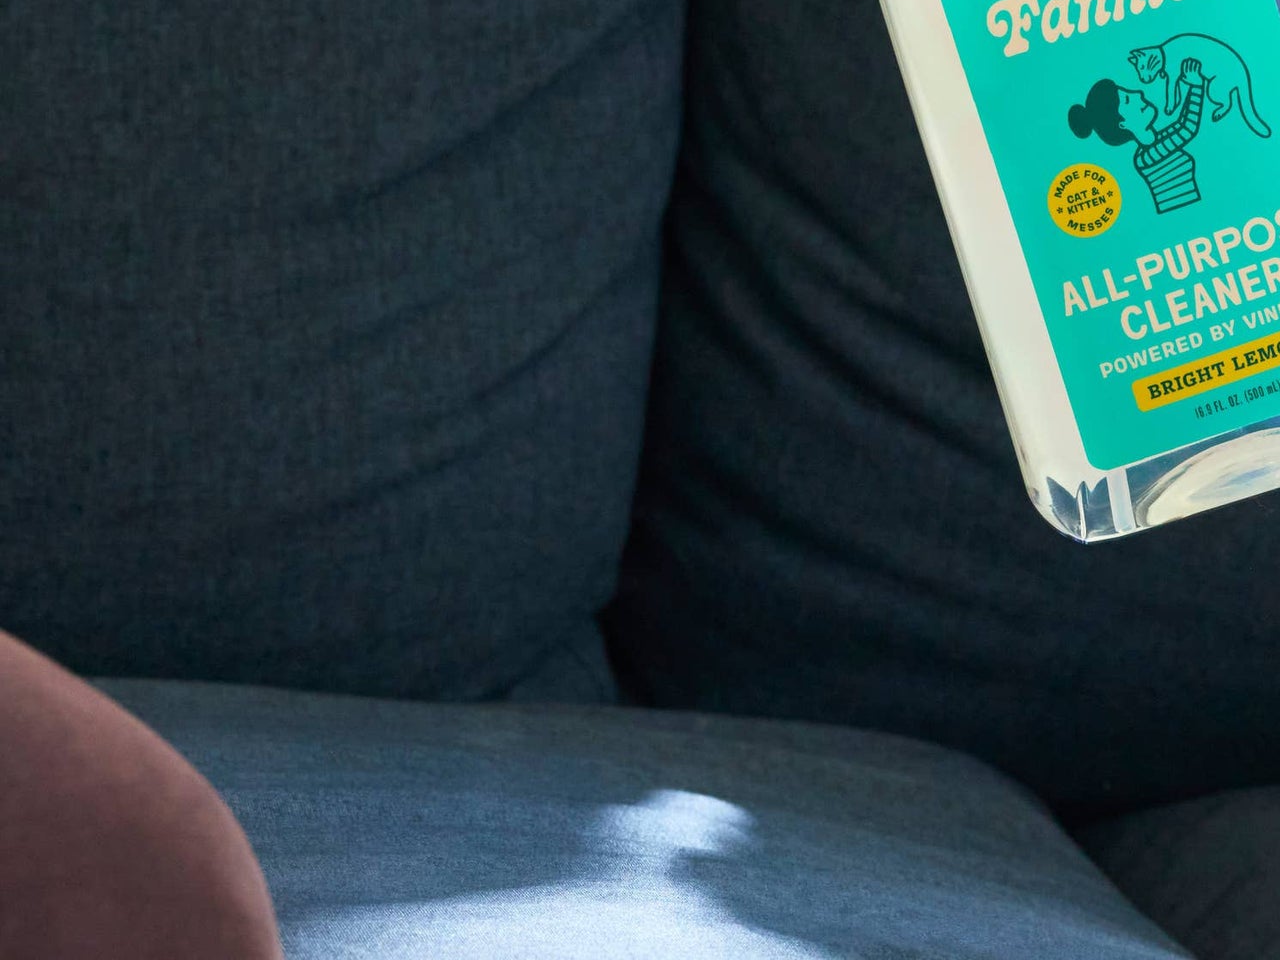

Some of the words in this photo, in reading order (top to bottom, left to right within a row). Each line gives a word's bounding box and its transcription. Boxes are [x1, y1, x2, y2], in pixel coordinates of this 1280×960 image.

[1054, 171, 1080, 198] MADE
[1084, 170, 1106, 185] FOR
[1067, 190, 1087, 204] CAT
[1091, 187, 1099, 196] &
[1067, 195, 1106, 214] KITTEN
[1067, 207, 1114, 231] MESSES
[1099, 331, 1203, 378] POWERED
[1209, 320, 1235, 342] BY
[1148, 362, 1225, 400] BRIGHT
[1195, 402, 1213, 419] 16.9
[1214, 397, 1227, 411] FL.
[1228, 393, 1243, 407] OZ.
[1243, 386, 1265, 404] (500
